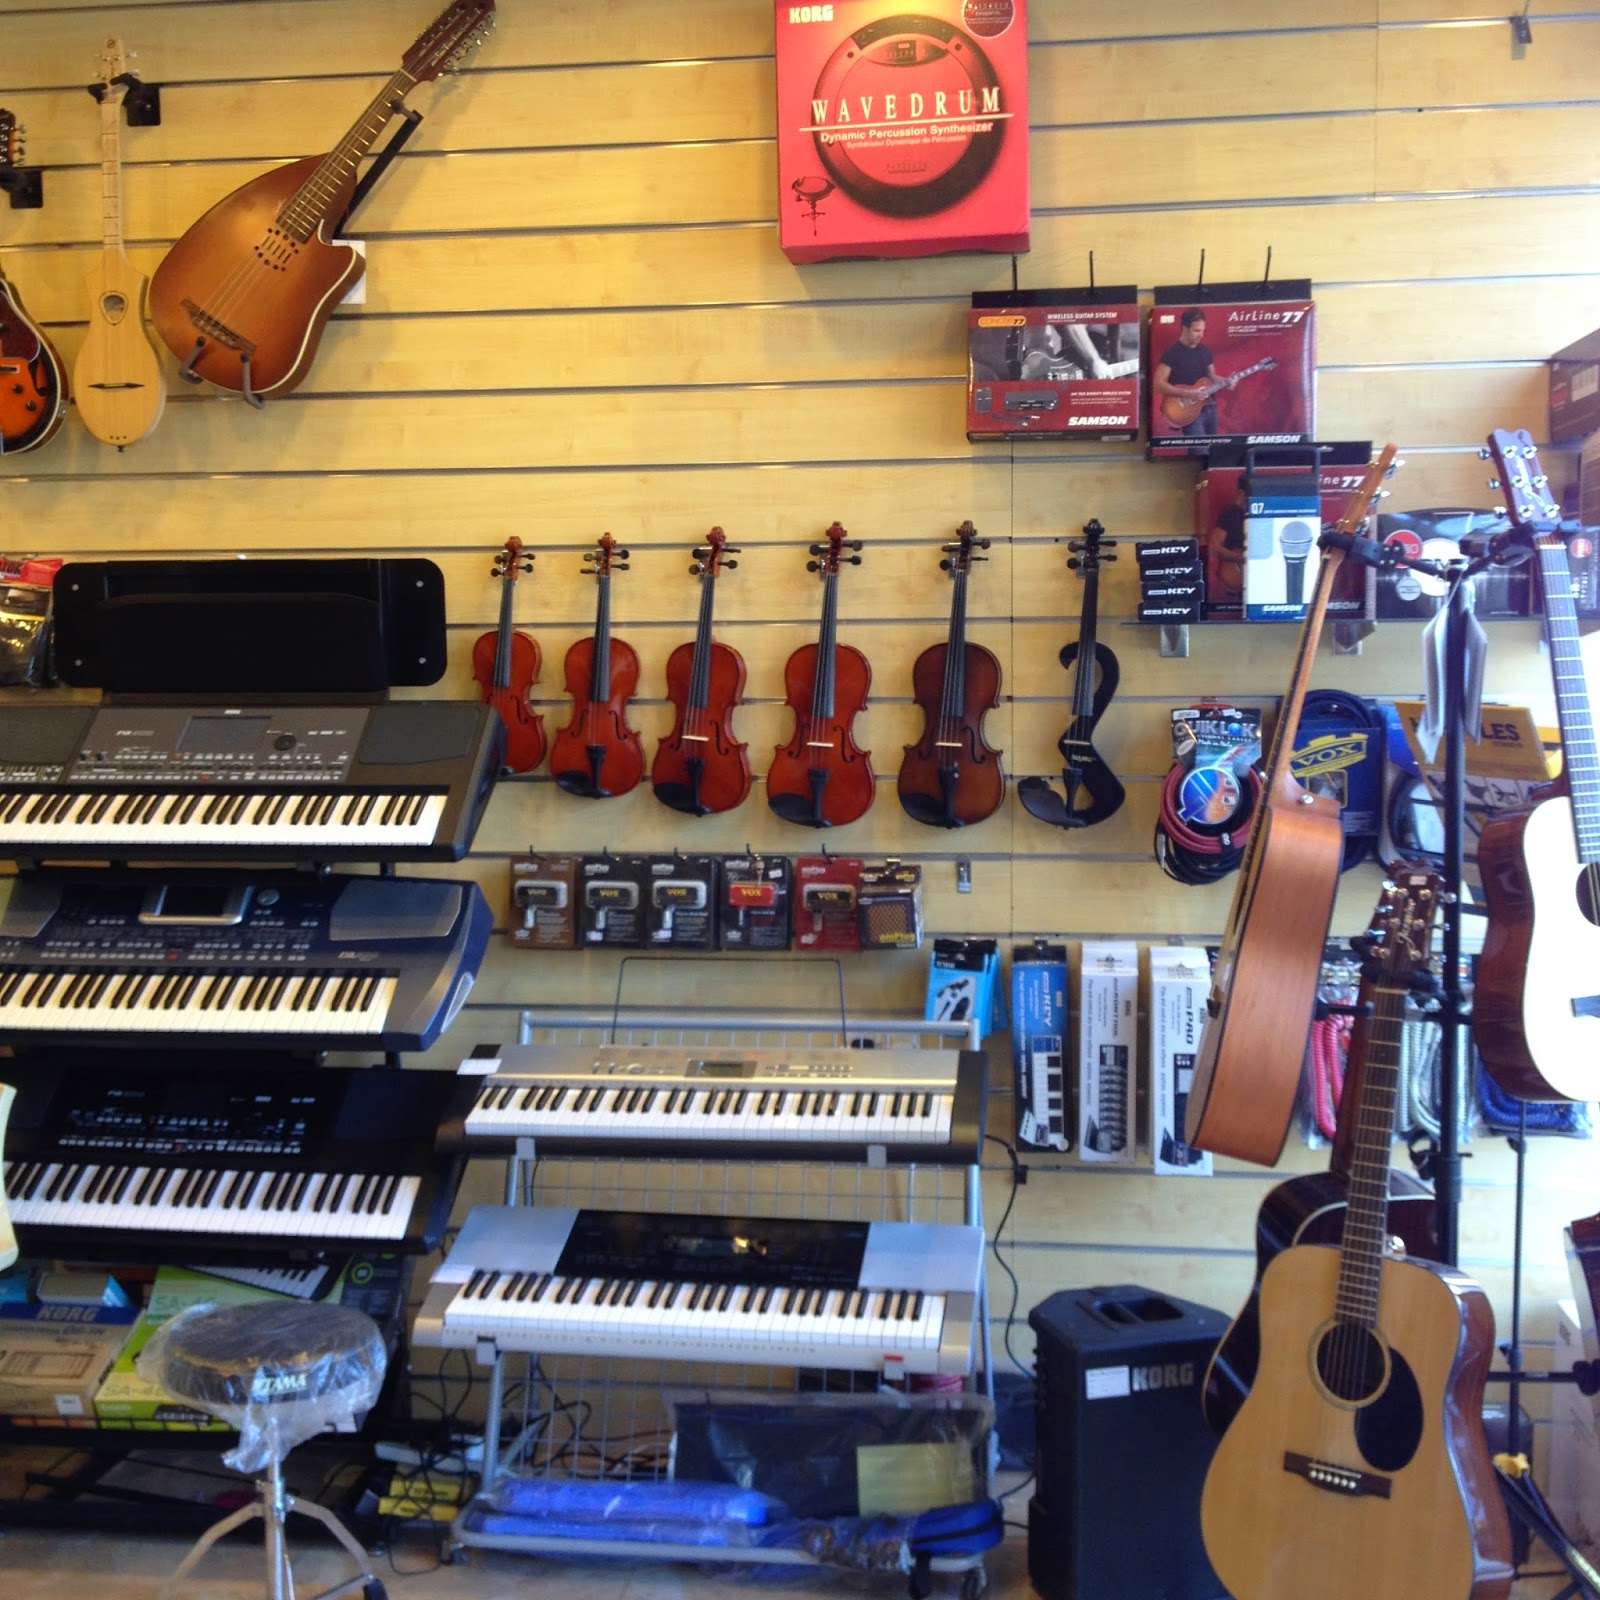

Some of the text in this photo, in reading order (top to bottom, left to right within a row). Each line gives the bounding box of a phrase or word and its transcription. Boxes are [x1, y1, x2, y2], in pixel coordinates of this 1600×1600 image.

[789, 5, 834, 24] KORG
[812, 87, 1000, 124] WAVEDRUM
[820, 122, 993, 143] Dynamic Percussion Synthesizer
[1228, 311, 1305, 323] AirLine 77
[1068, 416, 1129, 426] SAMSON
[1246, 435, 1301, 444] SAMSON
[1341, 476, 1365, 487] 77
[1251, 502, 1264, 514] Q7
[1262, 604, 1303, 612] SAMSON
[1296, 742, 1358, 766] VOX
[741, 887, 761, 897] VOX
[37, 1305, 98, 1321] KORG
[1131, 1363, 1194, 1392] KORG
